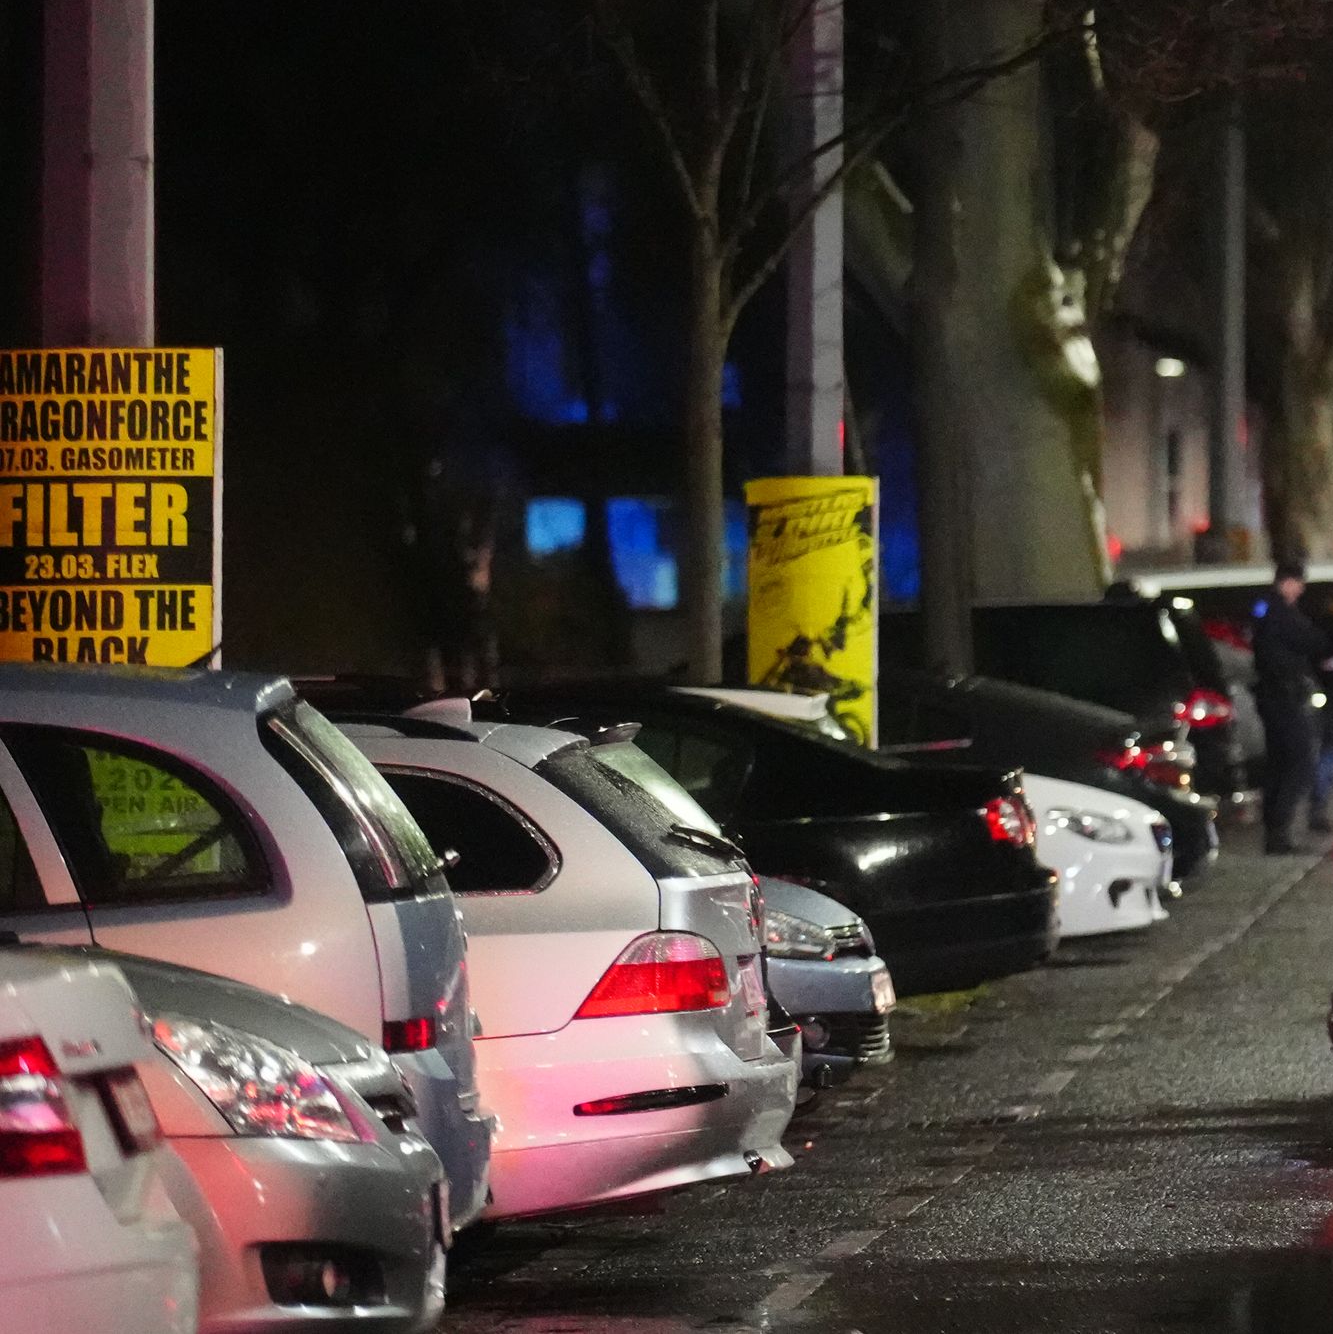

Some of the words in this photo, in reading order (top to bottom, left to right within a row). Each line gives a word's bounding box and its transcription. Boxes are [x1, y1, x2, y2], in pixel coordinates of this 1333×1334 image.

[0, 353, 190, 395] AMARANTHE
[61, 447, 195, 472] GASOMETER
[0, 482, 189, 546] FILTER
[25, 554, 100, 579] 23.03.
[107, 553, 159, 579] FLEX
[134, 589, 196, 631] THE
[33, 636, 149, 665] BLACK
